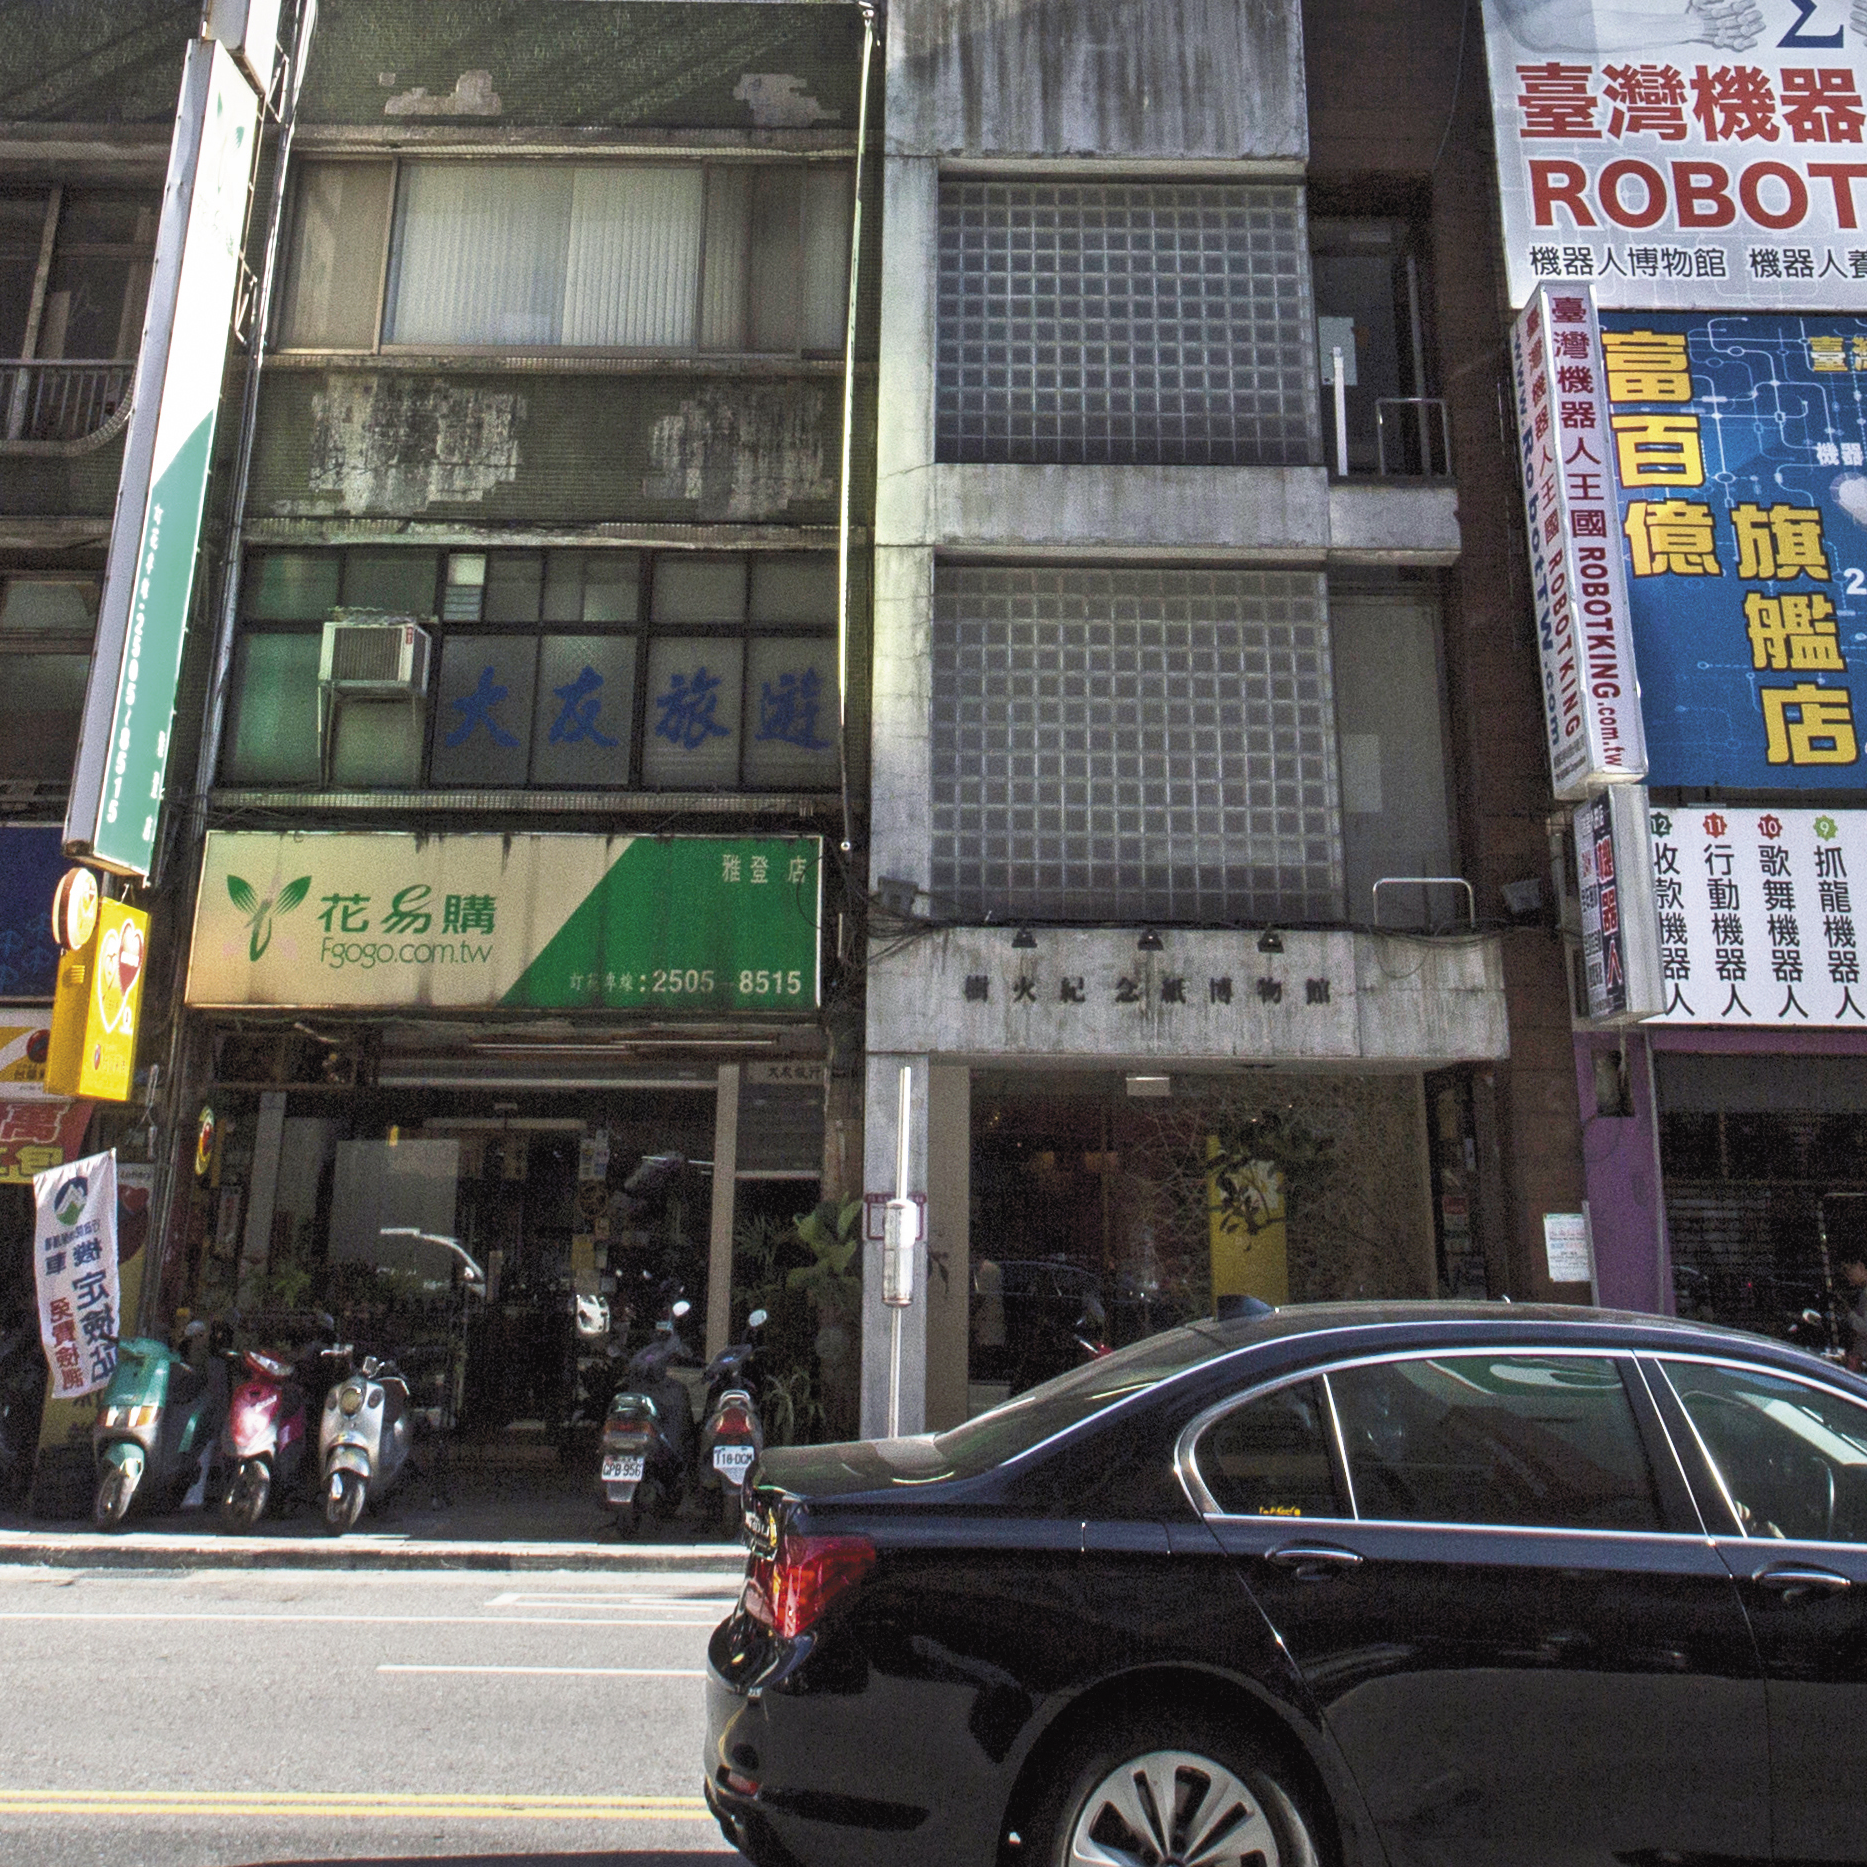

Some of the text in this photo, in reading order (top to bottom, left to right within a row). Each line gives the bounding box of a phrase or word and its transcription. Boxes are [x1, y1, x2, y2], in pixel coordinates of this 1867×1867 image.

[1528, 246, 1727, 280] 機器人博物館
[1551, 296, 1608, 539] 臺灣機器人王國
[1600, 330, 1724, 577] 富百億
[1548, 547, 1581, 738] ROBOTKING
[1578, 547, 1625, 768] ROBOTKING.com.tw
[1729, 502, 1860, 767] 旗艦店
[318, 883, 498, 936] 花易購
[320, 936, 494, 969] Fgogo.com.tw
[721, 853, 808, 885] 雅登店
[1595, 834, 1623, 989] 機器人
[1653, 842, 1696, 1017] 收款機器人
[1703, 843, 1753, 1018] 行動機器人
[1757, 844, 1810, 1019] 歌舞機器人
[1813, 845, 1866, 1020] 抓龍機器人
[963, 974, 1333, 1006] 樹火紀念紙博物館
